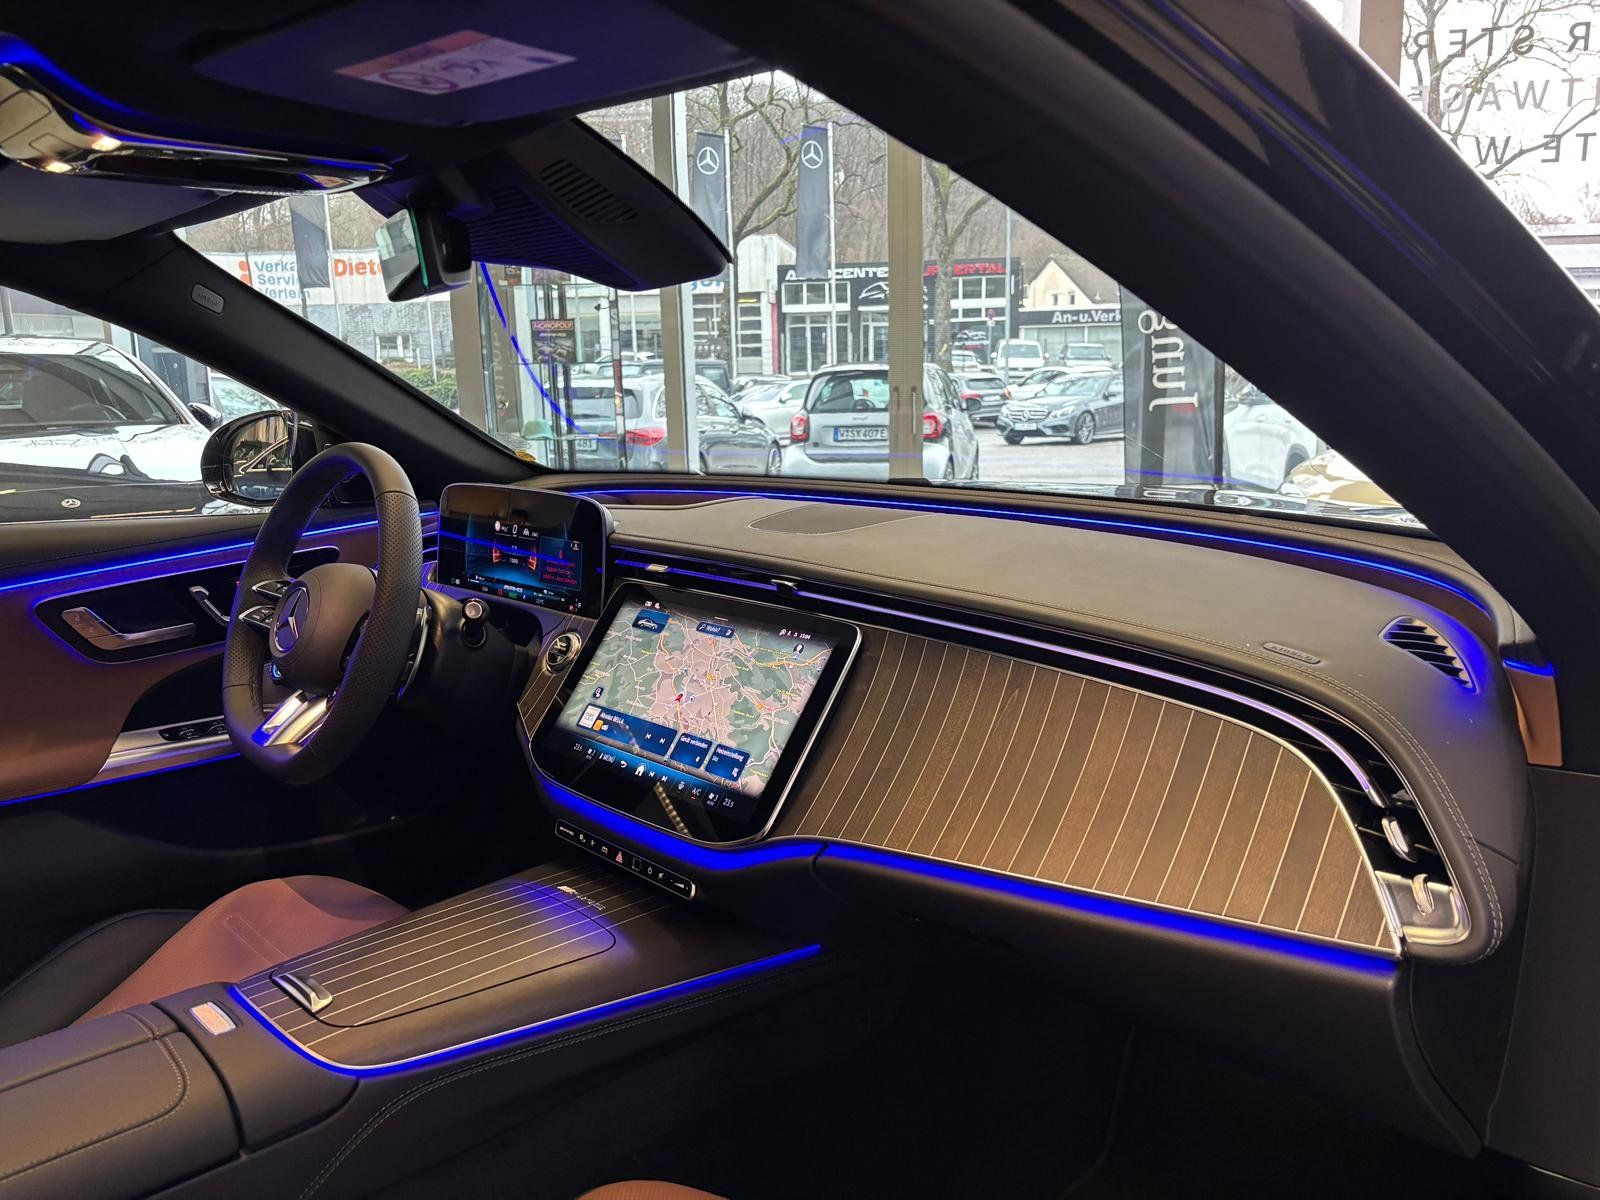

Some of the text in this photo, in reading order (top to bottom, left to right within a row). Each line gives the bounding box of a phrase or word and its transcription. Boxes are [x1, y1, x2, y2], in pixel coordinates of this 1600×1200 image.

[257, 273, 299, 285] Servi
[785, 267, 889, 280] ACENTE
[533, 321, 573, 329] MONOPOLY
